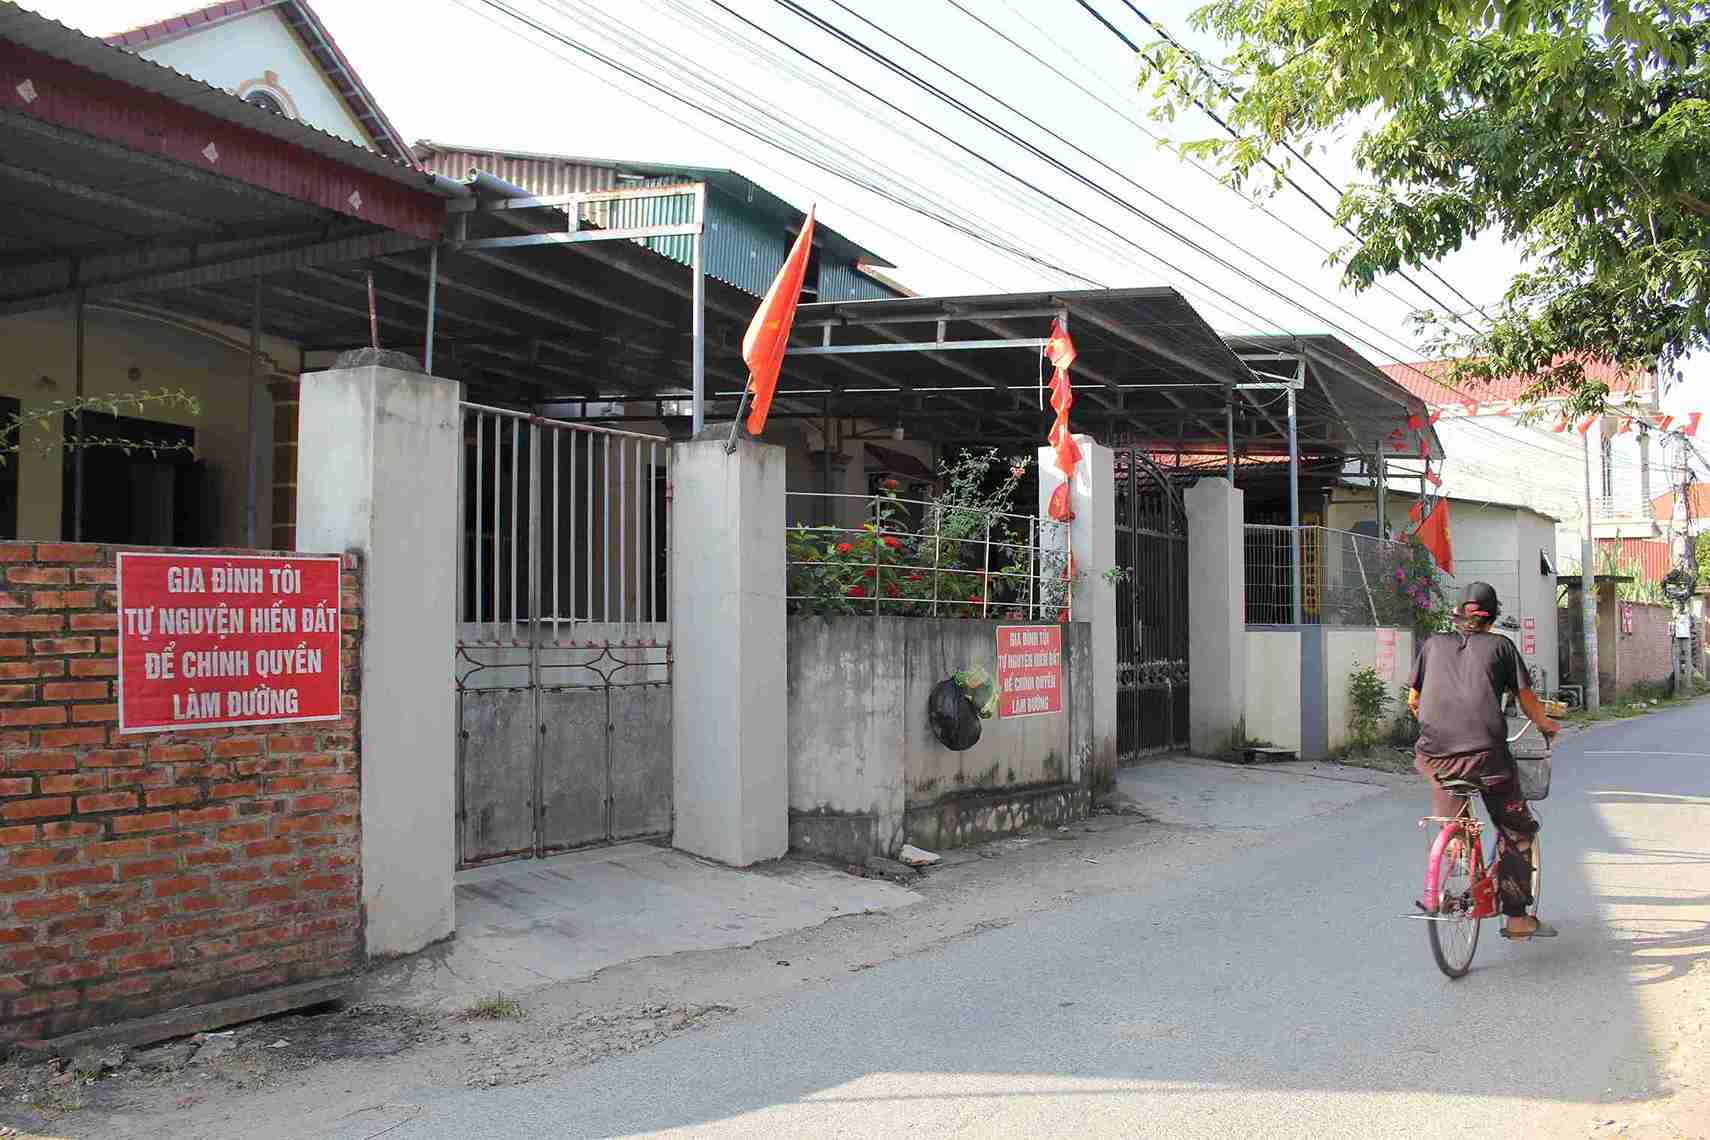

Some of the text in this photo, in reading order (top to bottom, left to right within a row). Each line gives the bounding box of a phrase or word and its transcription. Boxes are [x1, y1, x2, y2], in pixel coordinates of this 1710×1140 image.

[167, 561, 302, 594] GIA ĐÌNH TÔI
[124, 605, 155, 641] TỰ
[159, 602, 244, 640] NGUYỆN
[250, 599, 297, 633] HIẾN
[144, 640, 322, 680] ĐỂ CHÍNH QUYỀN
[173, 683, 299, 720] LÀM ĐƯỜNG
